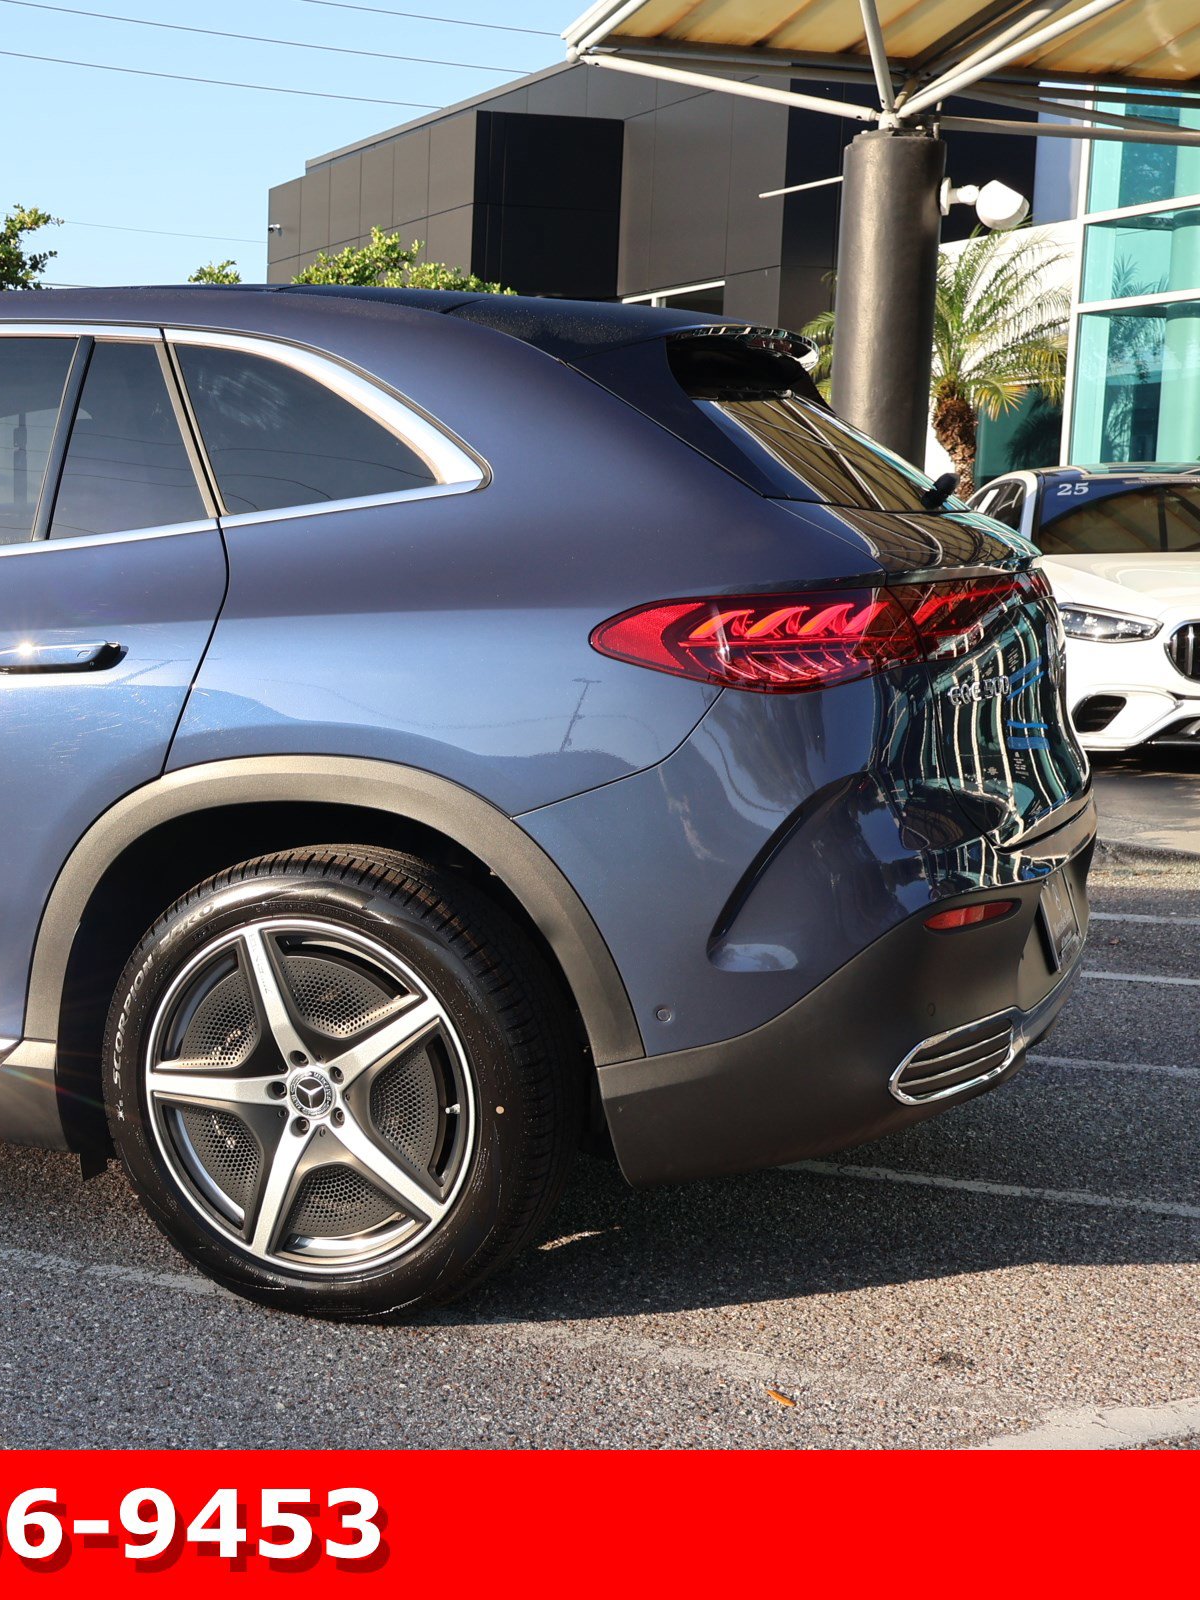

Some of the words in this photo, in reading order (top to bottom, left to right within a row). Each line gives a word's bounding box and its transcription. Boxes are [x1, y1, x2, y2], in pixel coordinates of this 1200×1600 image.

[1057, 482, 1089, 496] 25
[947, 682, 982, 706] EQE
[983, 675, 1009, 699] 500
[112, 953, 154, 1090] SCORPION
